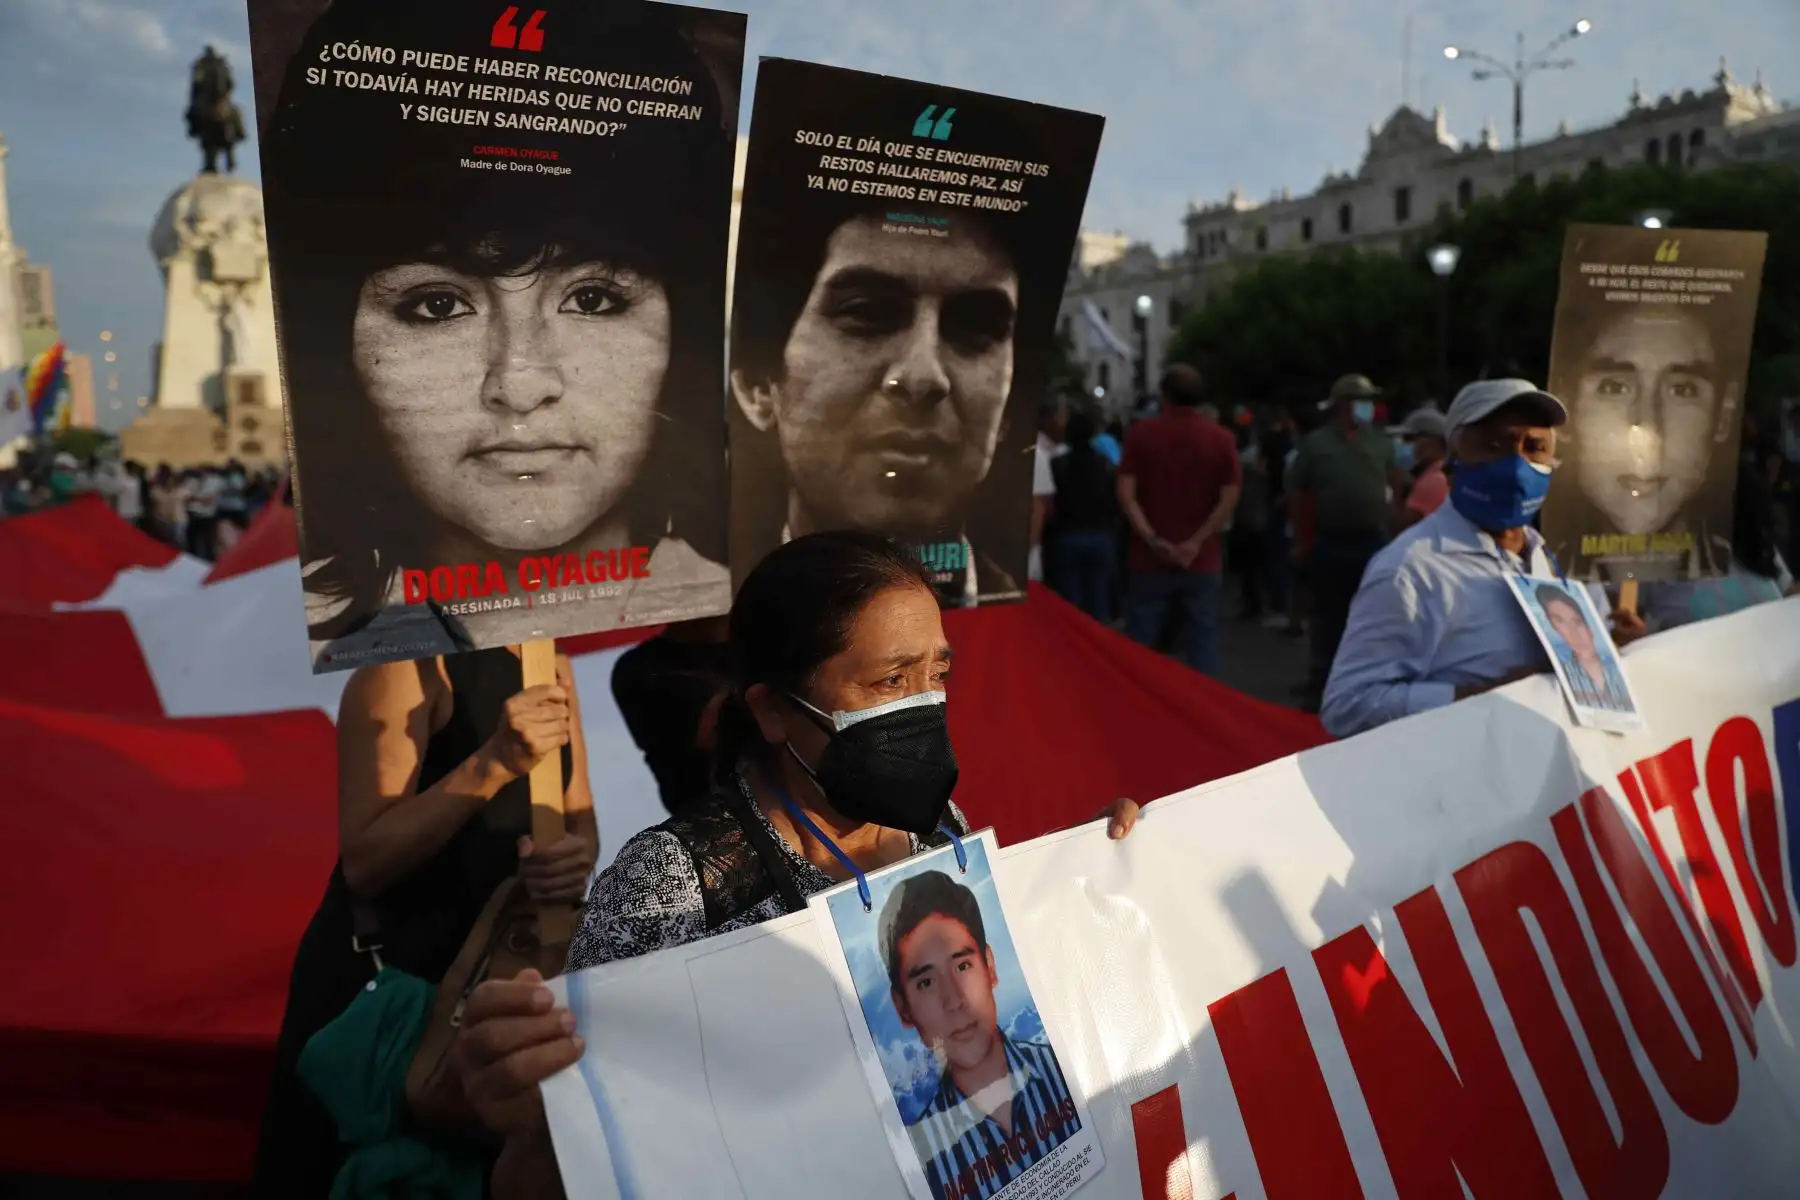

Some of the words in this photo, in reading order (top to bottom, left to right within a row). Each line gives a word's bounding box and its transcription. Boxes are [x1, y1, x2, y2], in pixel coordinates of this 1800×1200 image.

[319, 40, 396, 66] ¿CÓMO
[401, 51, 469, 73] PUEDE
[474, 57, 540, 80] HABER
[544, 66, 693, 96] RECONCILIACIÓN
[305, 67, 327, 86] SI
[332, 69, 420, 95] TODAVÍA
[424, 80, 464, 100] HAY
[468, 84, 550, 107] HERIDAS
[554, 91, 592, 113] QUE
[596, 96, 621, 114] NO
[626, 100, 703, 122] CIERRAN
[399, 104, 413, 120] Y
[416, 105, 490, 127] SIGUEN
[460, 159, 493, 170] Madre
[494, 161, 508, 171] de
[509, 162, 534, 173] Dora
[536, 164, 572, 176] Oyague
[472, 145, 517, 158] CARMEN
[519, 148, 560, 161] OYAGUE
[794, 130, 835, 148] SOLO
[836, 136, 853, 150] EL
[857, 136, 881, 154] DÍA
[884, 142, 914, 159] QUE
[915, 146, 933, 160] SE
[936, 150, 1023, 173] ENCUENTREN
[1023, 161, 1050, 177] SUS
[806, 175, 824, 189] YA
[827, 178, 849, 191] NO
[851, 180, 916, 200] ESTEMOS
[917, 188, 937, 202] EN
[939, 191, 971, 207] ESTE
[819, 155, 876, 174] RESTOS
[877, 163, 967, 186] HALLAREMOS
[999, 178, 1024, 193] ASÍ
[403, 561, 509, 606] DORA
[518, 546, 650, 590] OYAGUE
[441, 597, 521, 617] ASESINADA
[1011, 1180, 1021, 1191] DE
[1051, 1151, 1060, 1159] DE
[1060, 1144, 1068, 1154] LA
[1027, 1178, 1039, 1189] DEL
[1039, 1160, 1061, 1179] CALLAO
[1041, 1168, 1075, 1200] INCINERADO
[1074, 1163, 1083, 1172] EN
[1083, 1157, 1091, 1166] EL
[1044, 1157, 1076, 1187] CONDUCIDO
[1076, 1153, 1083, 1163] AL
